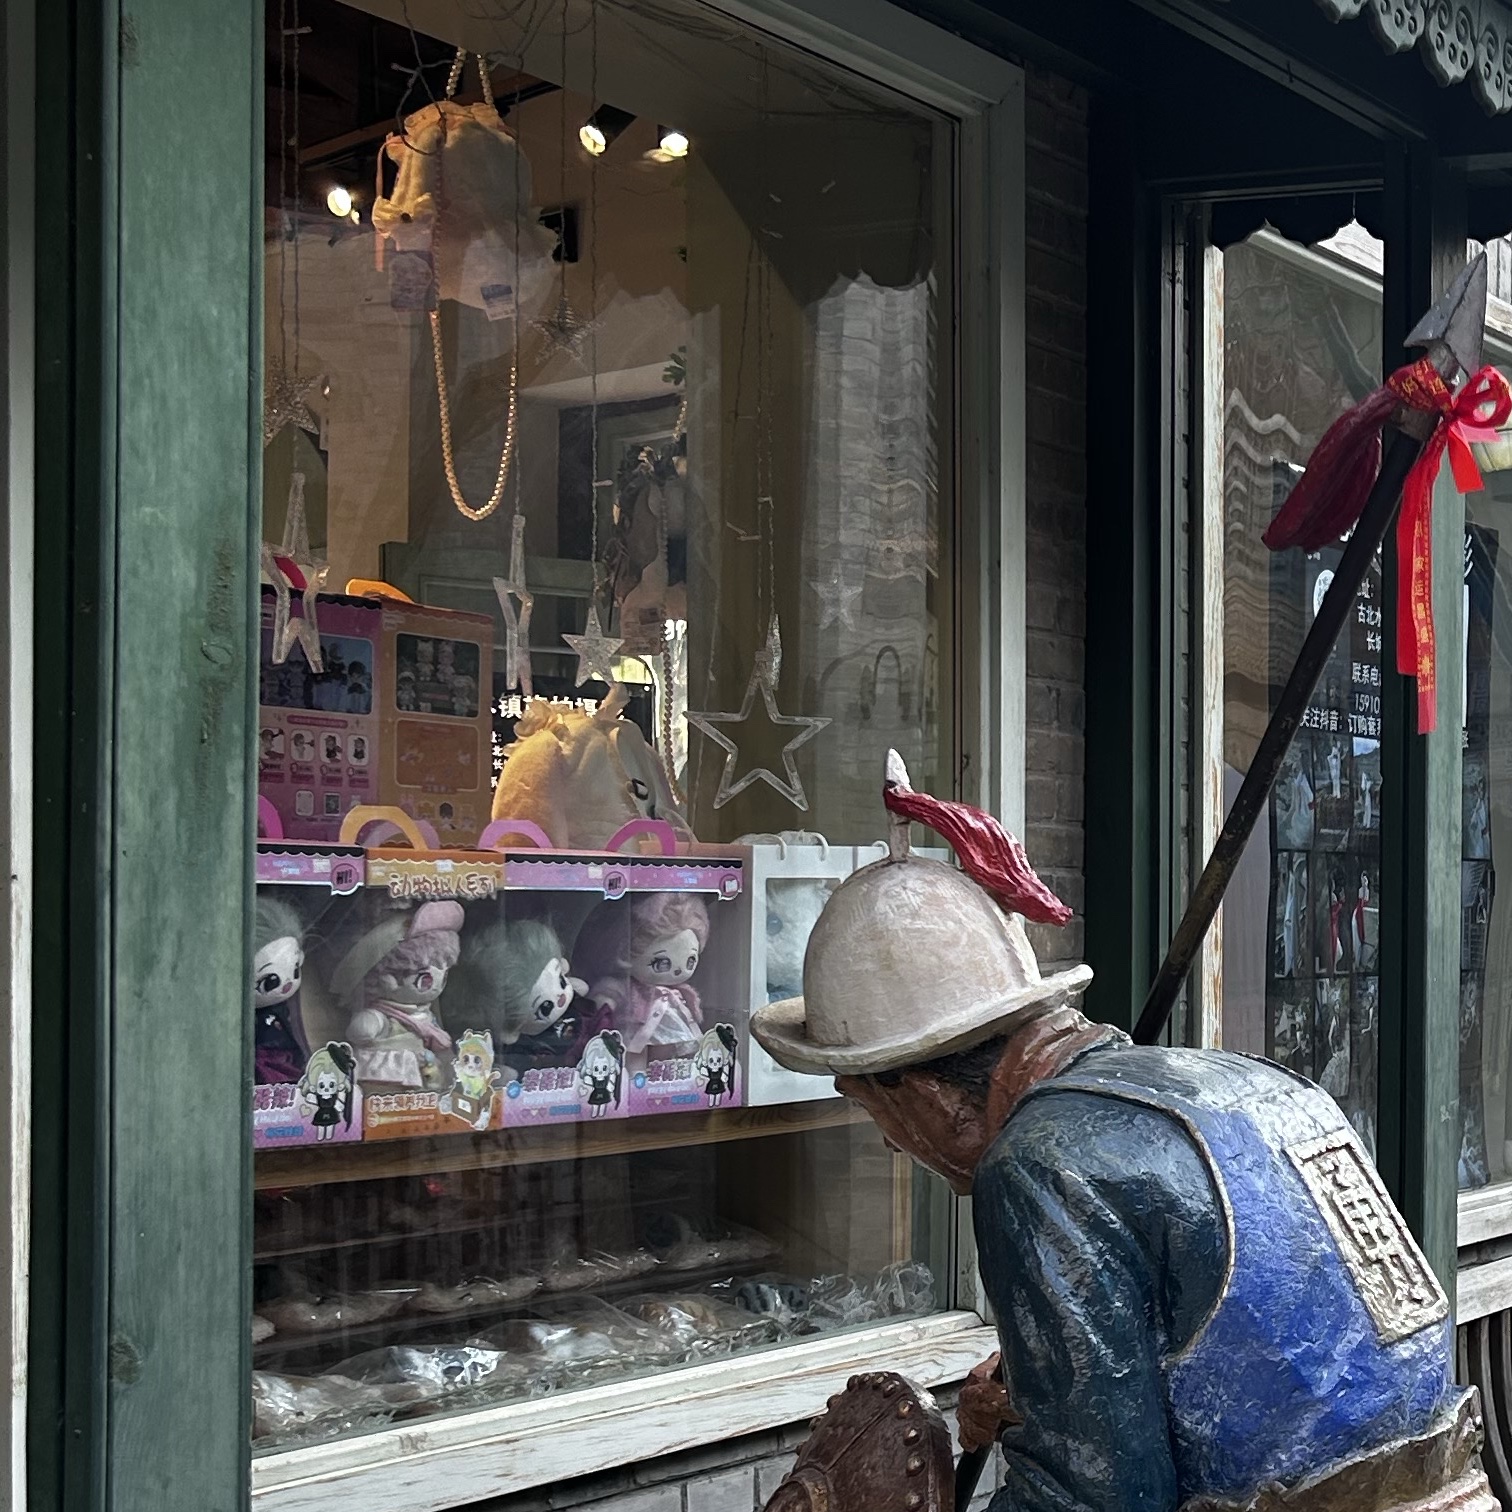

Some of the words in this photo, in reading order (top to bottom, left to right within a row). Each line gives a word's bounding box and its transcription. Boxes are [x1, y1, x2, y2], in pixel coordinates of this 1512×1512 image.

[1352, 662, 1382, 687] 联系电
[1355, 693, 1380, 715] 15910
